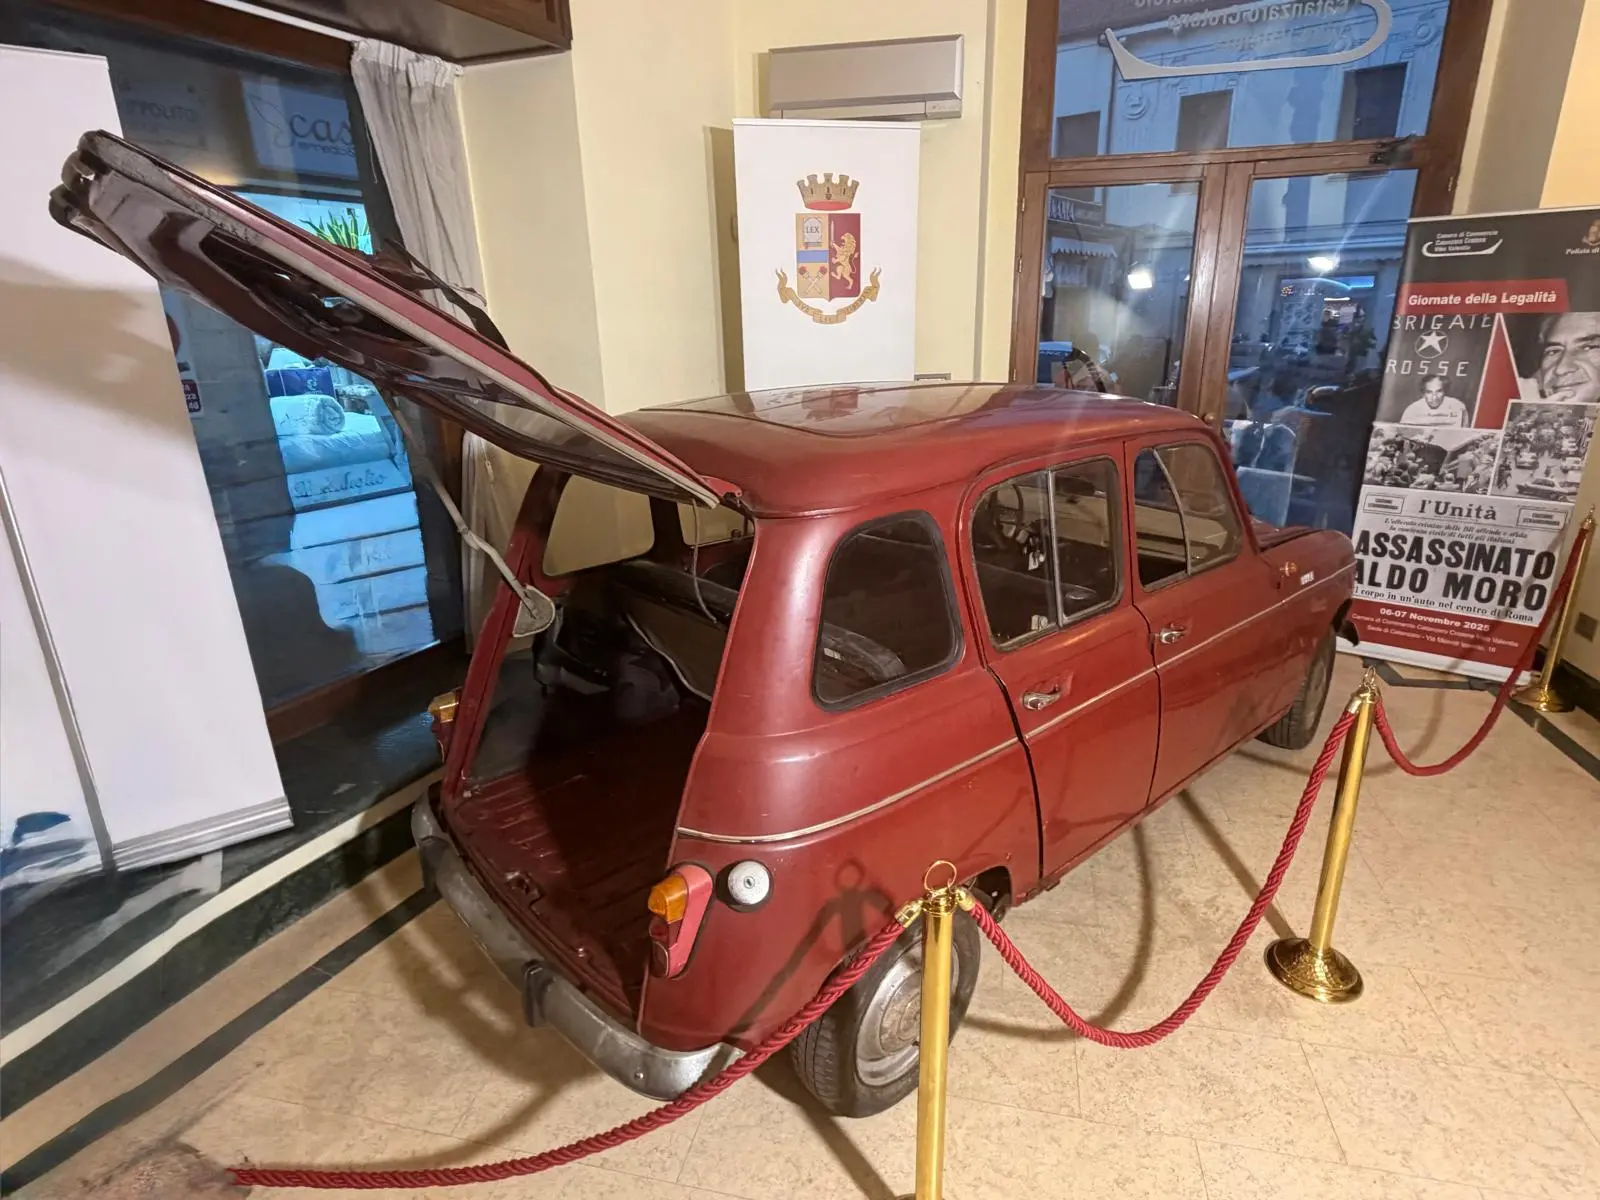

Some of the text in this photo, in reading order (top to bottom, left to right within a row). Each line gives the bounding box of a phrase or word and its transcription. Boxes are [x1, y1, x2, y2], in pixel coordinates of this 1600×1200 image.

[806, 225, 820, 234] LEX
[1408, 290, 1557, 306] Giornate della Legalità
[1385, 360, 1469, 377] ROSSE
[1418, 499, 1498, 521] l'Unità
[1354, 530, 1556, 580] ASSASSINATO
[1355, 558, 1429, 593] ALDO
[1442, 572, 1547, 611] MORO
[1361, 589, 1385, 598] corpo
[1387, 591, 1397, 600] in
[1399, 595, 1435, 606] un'auto
[1438, 601, 1454, 610] nel
[1455, 603, 1488, 615] centro
[1490, 607, 1501, 617] di
[1504, 608, 1534, 622] Roma
[1379, 607, 1491, 632] 06-07 Novembre 2025
